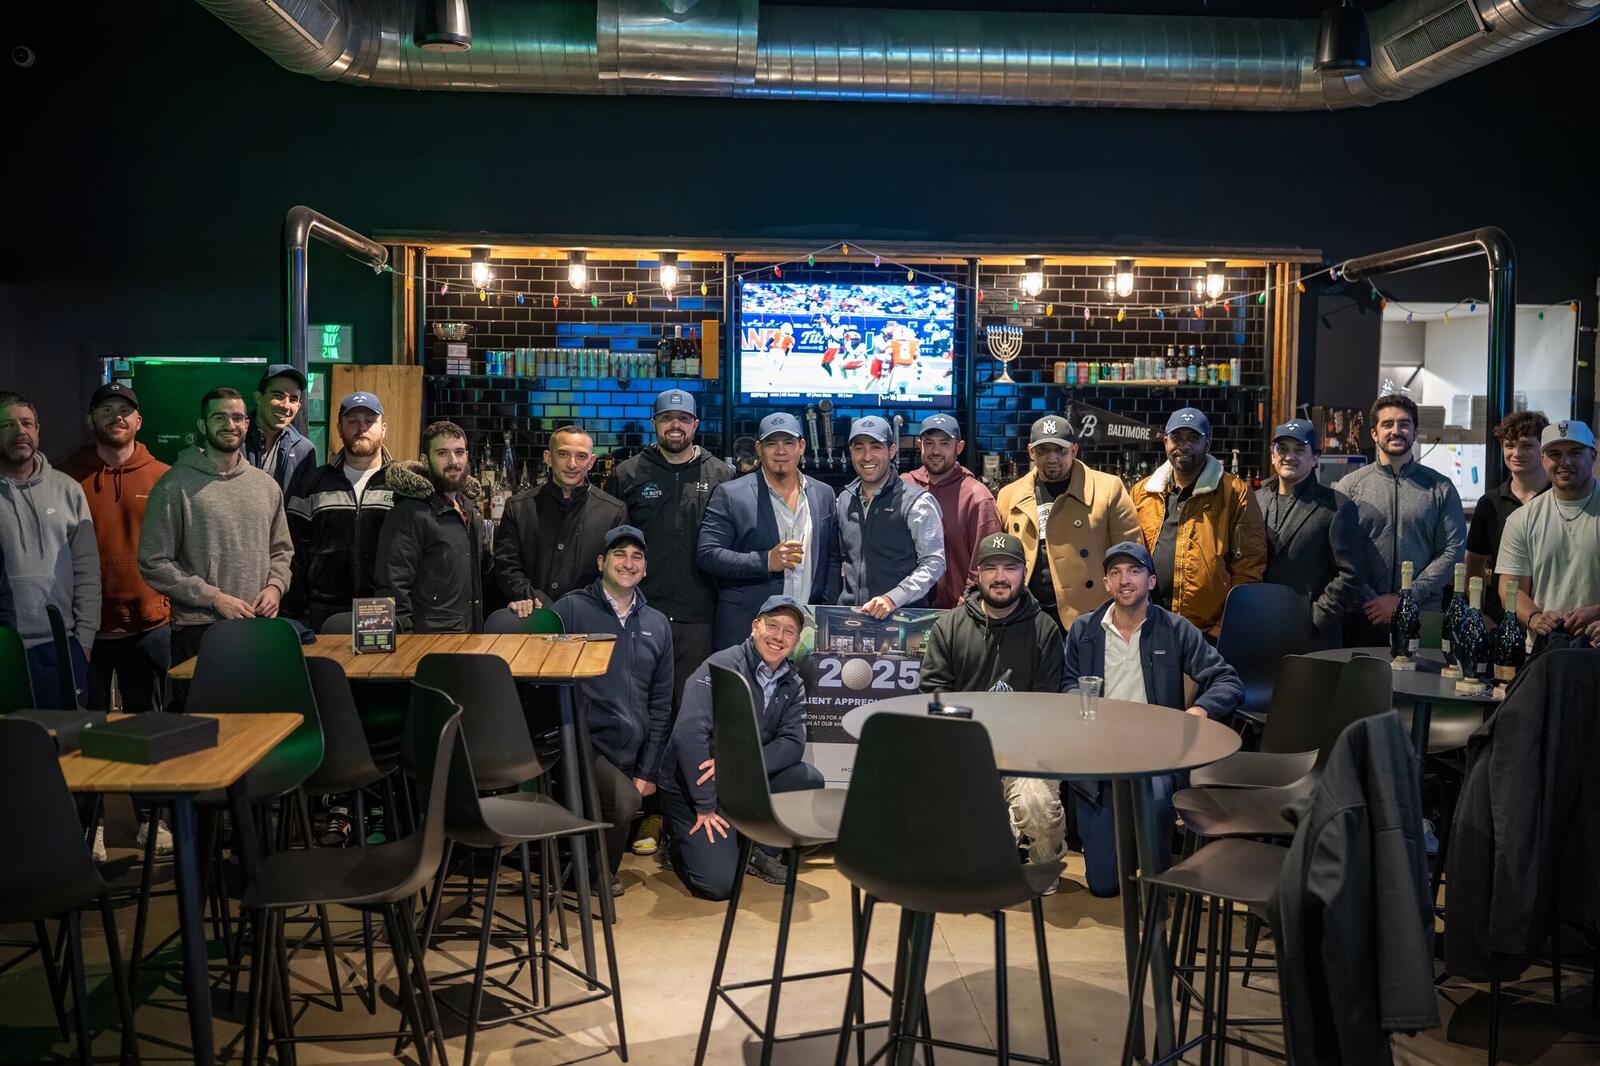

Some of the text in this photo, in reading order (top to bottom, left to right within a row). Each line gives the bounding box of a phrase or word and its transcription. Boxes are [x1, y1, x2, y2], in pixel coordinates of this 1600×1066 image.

[1078, 414, 1098, 438] B
[1107, 423, 1151, 440] BALTIMORE
[992, 536, 1006, 549] NY
[818, 657, 921, 691] 2025
[806, 696, 832, 705] IENT
